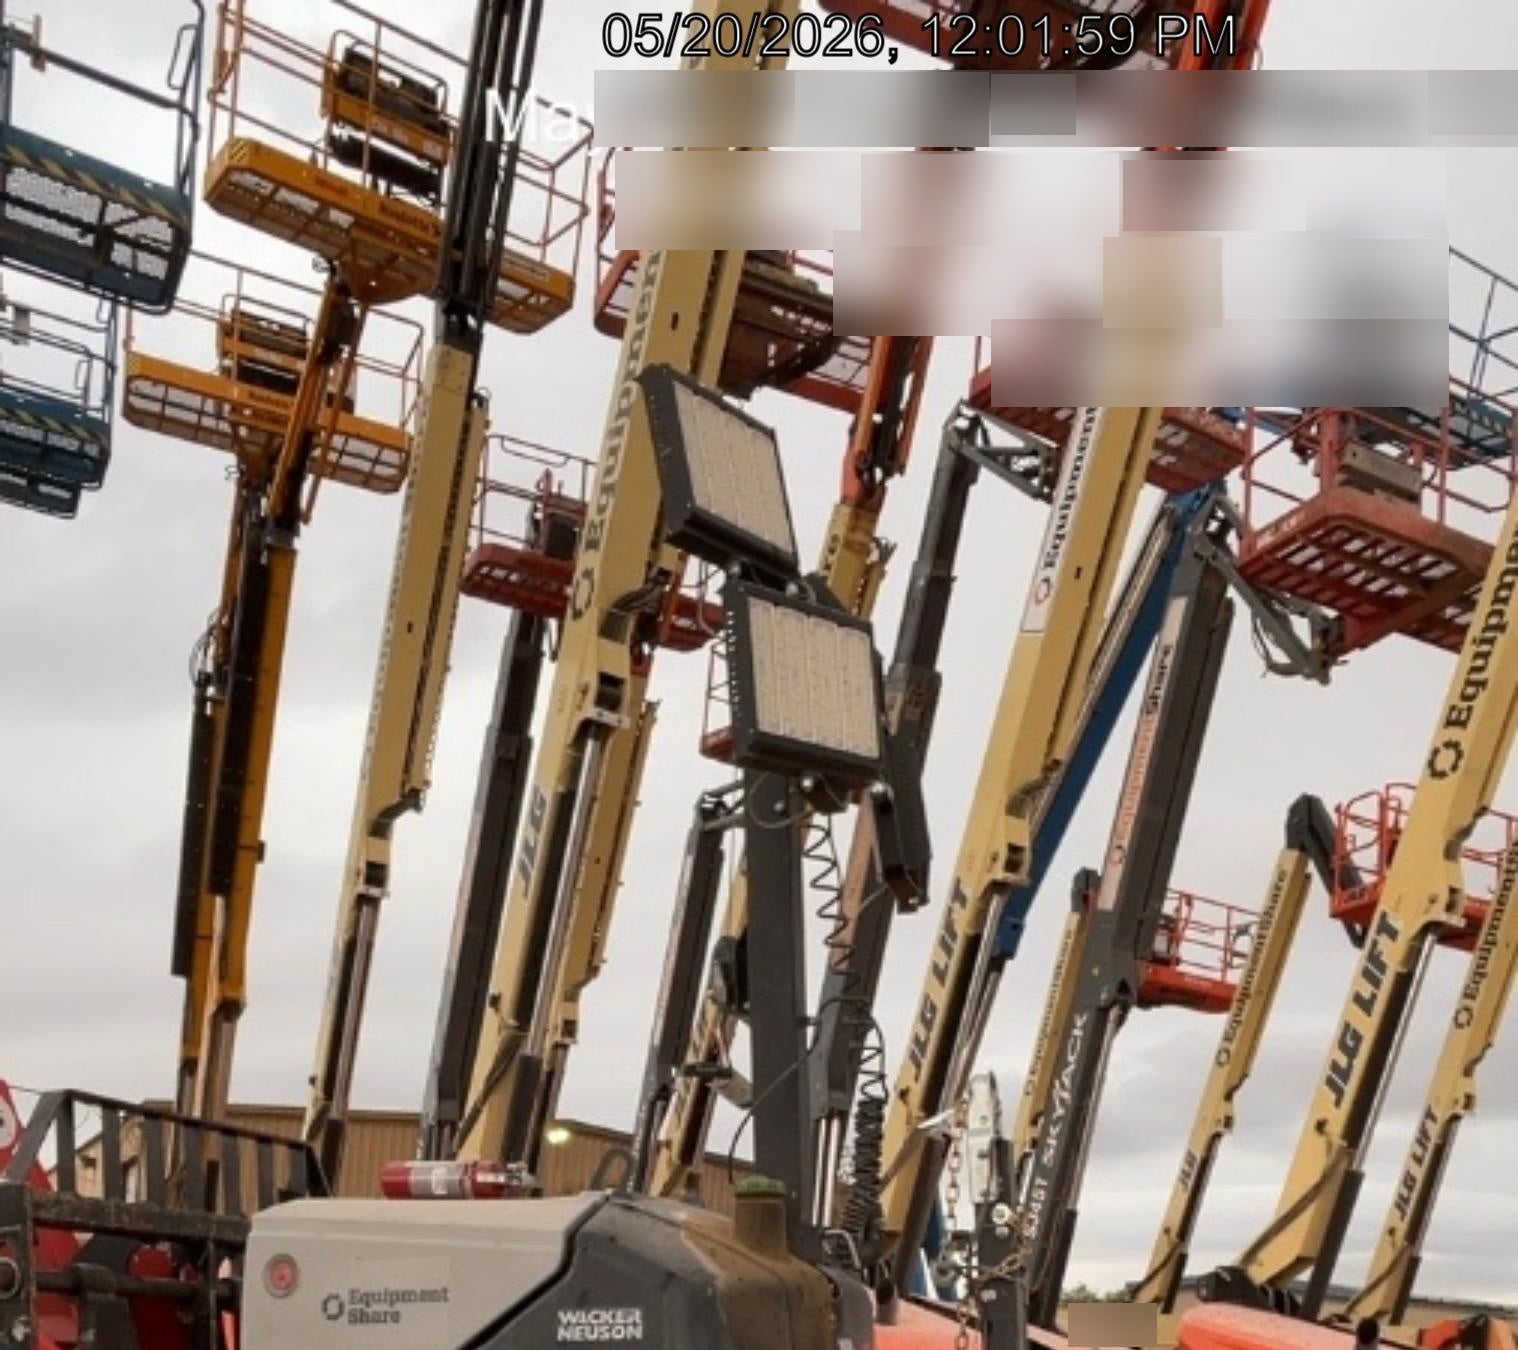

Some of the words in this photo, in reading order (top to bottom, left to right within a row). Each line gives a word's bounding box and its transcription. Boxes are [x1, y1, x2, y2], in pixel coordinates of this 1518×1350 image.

[582, 249, 666, 550] Equipmen
[518, 784, 548, 899] JLG
[908, 992, 937, 1083] JLG
[932, 876, 967, 988] LIFT
[1325, 1018, 1364, 1109] JLG
[1352, 910, 1399, 1018] LIFT
[1394, 1169, 1417, 1222] JLG
[1411, 1104, 1438, 1169] LIFT
[347, 1308, 401, 1324] Share
[348, 1286, 450, 1309] Equipment
[557, 1307, 643, 1325] WACKER
[557, 1325, 644, 1342] NEUSON
